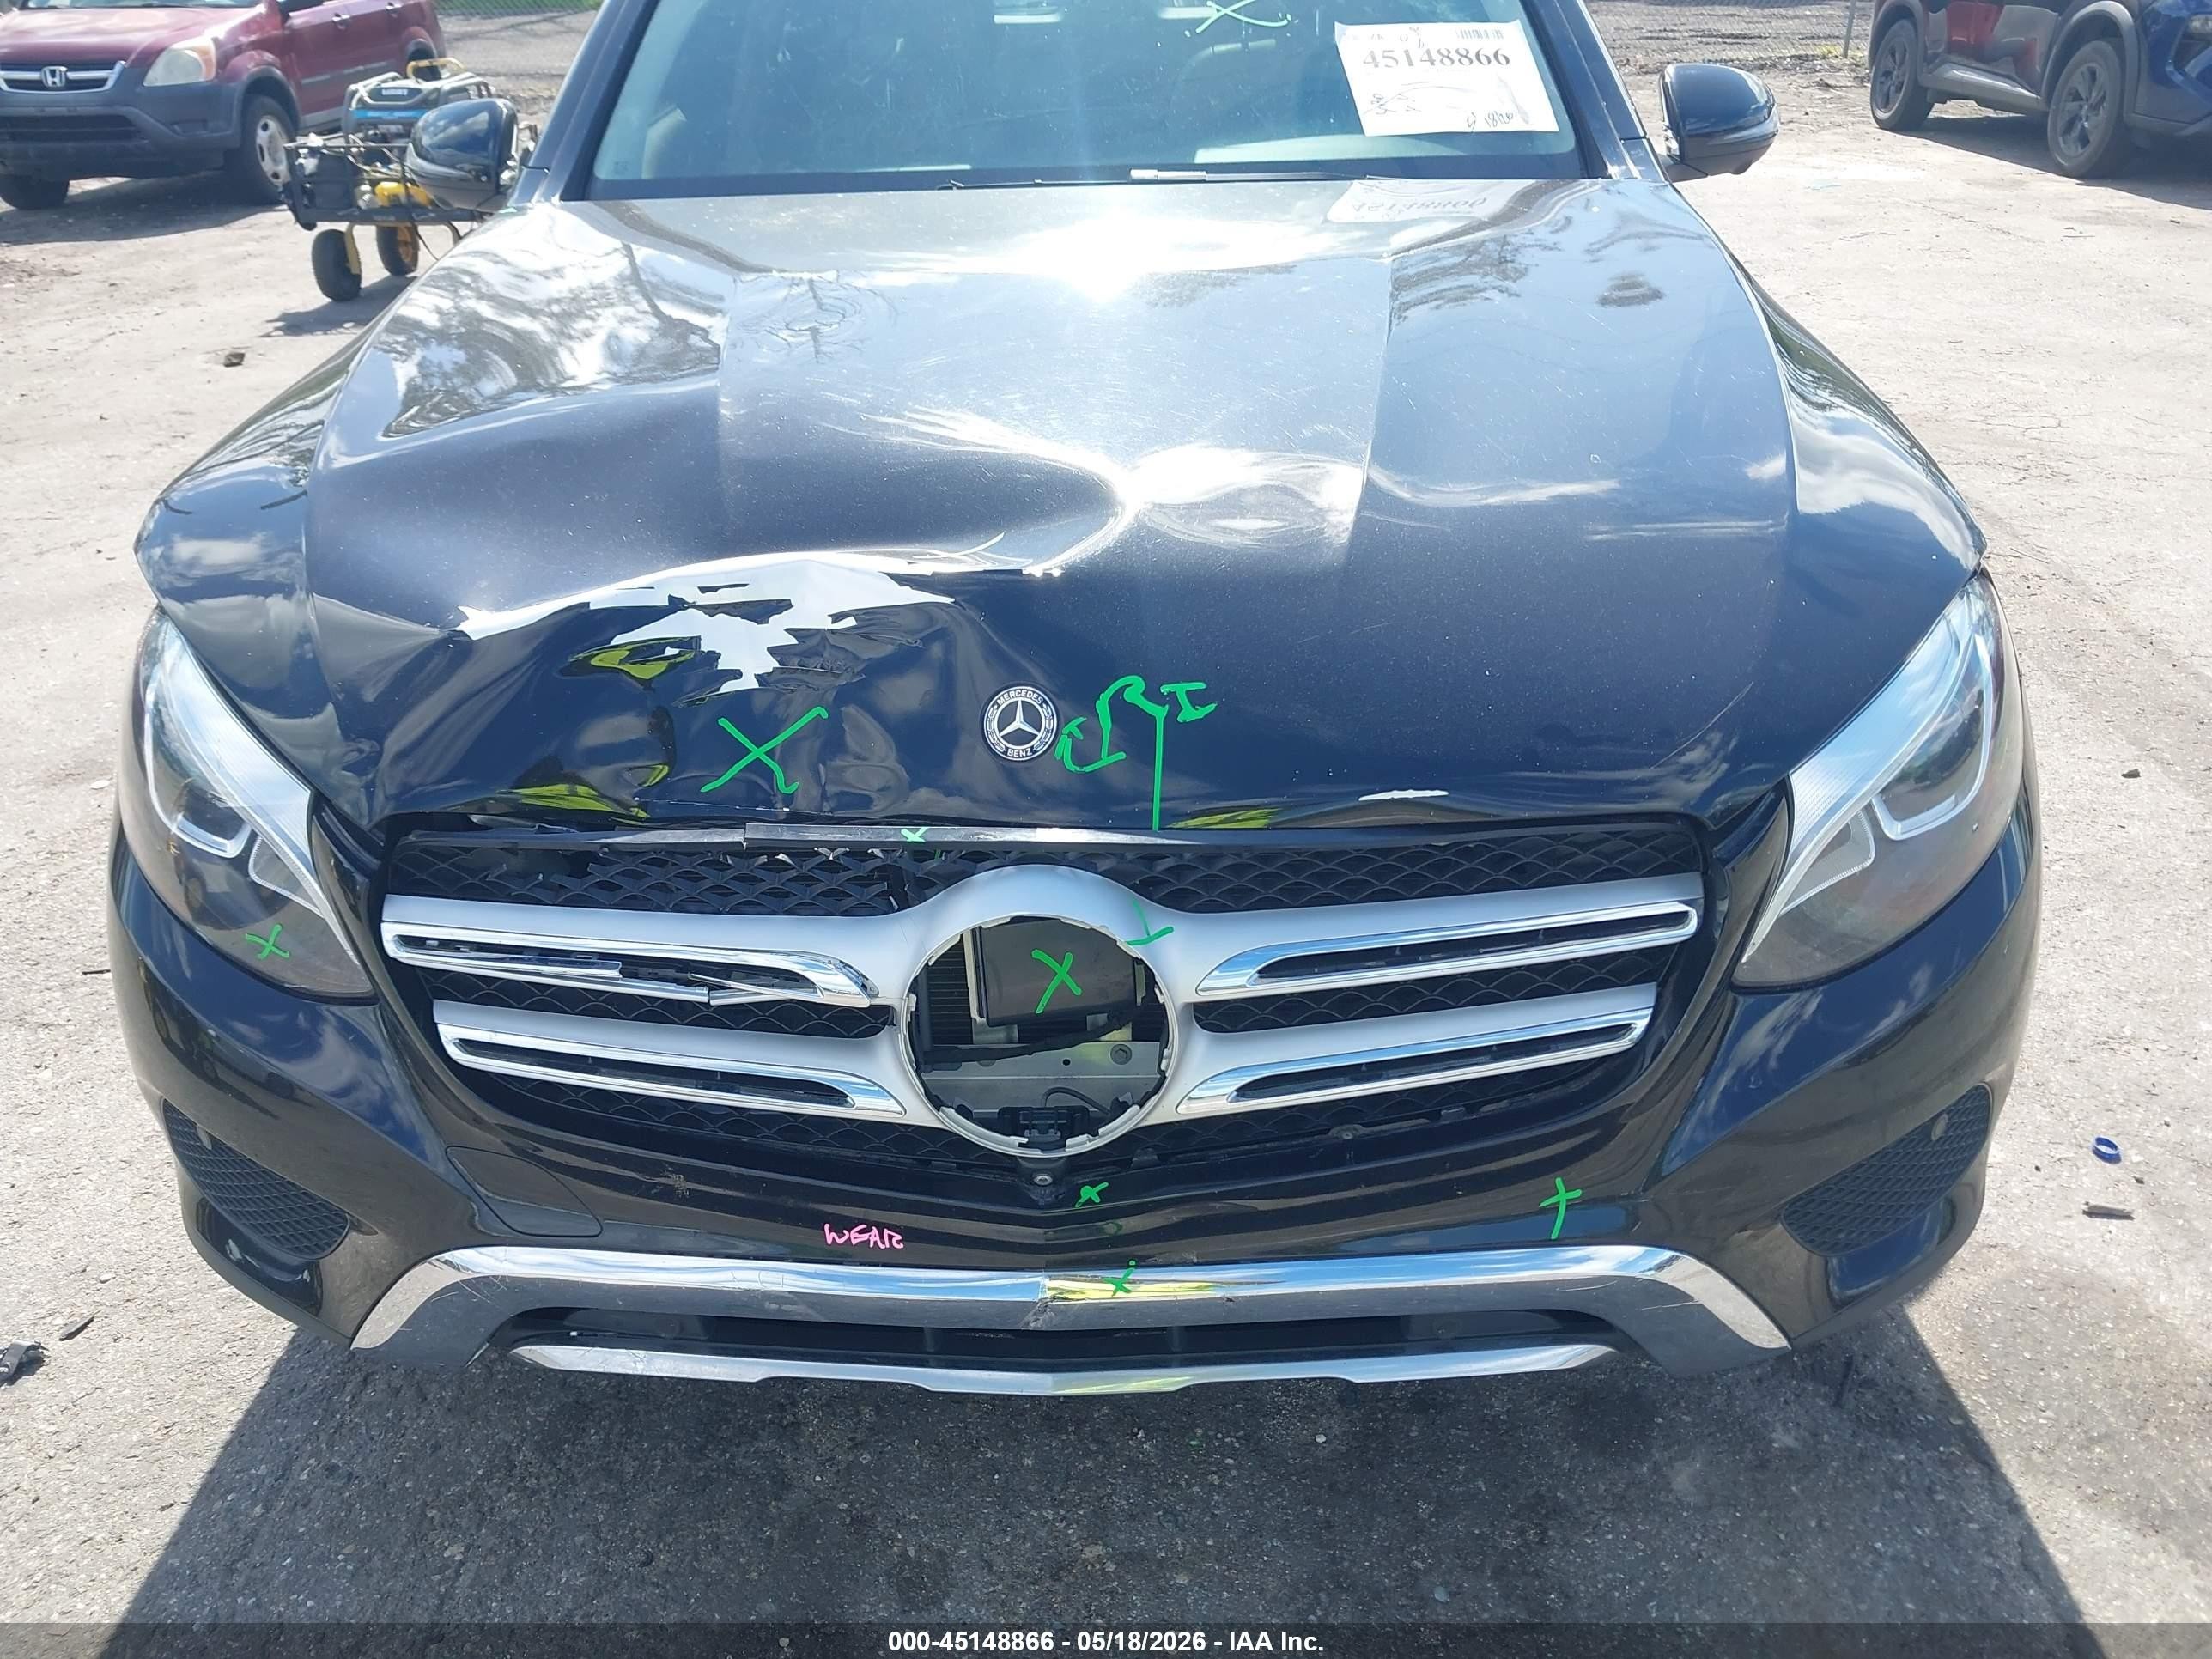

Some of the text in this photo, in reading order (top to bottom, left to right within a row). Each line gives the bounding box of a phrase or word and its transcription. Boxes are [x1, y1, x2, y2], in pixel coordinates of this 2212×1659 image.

[1363, 47, 1511, 68] 45148866
[996, 690, 1044, 706] MERCEDES
[1006, 747, 1033, 757] BENZ
[823, 1223, 904, 1249] WEAR
